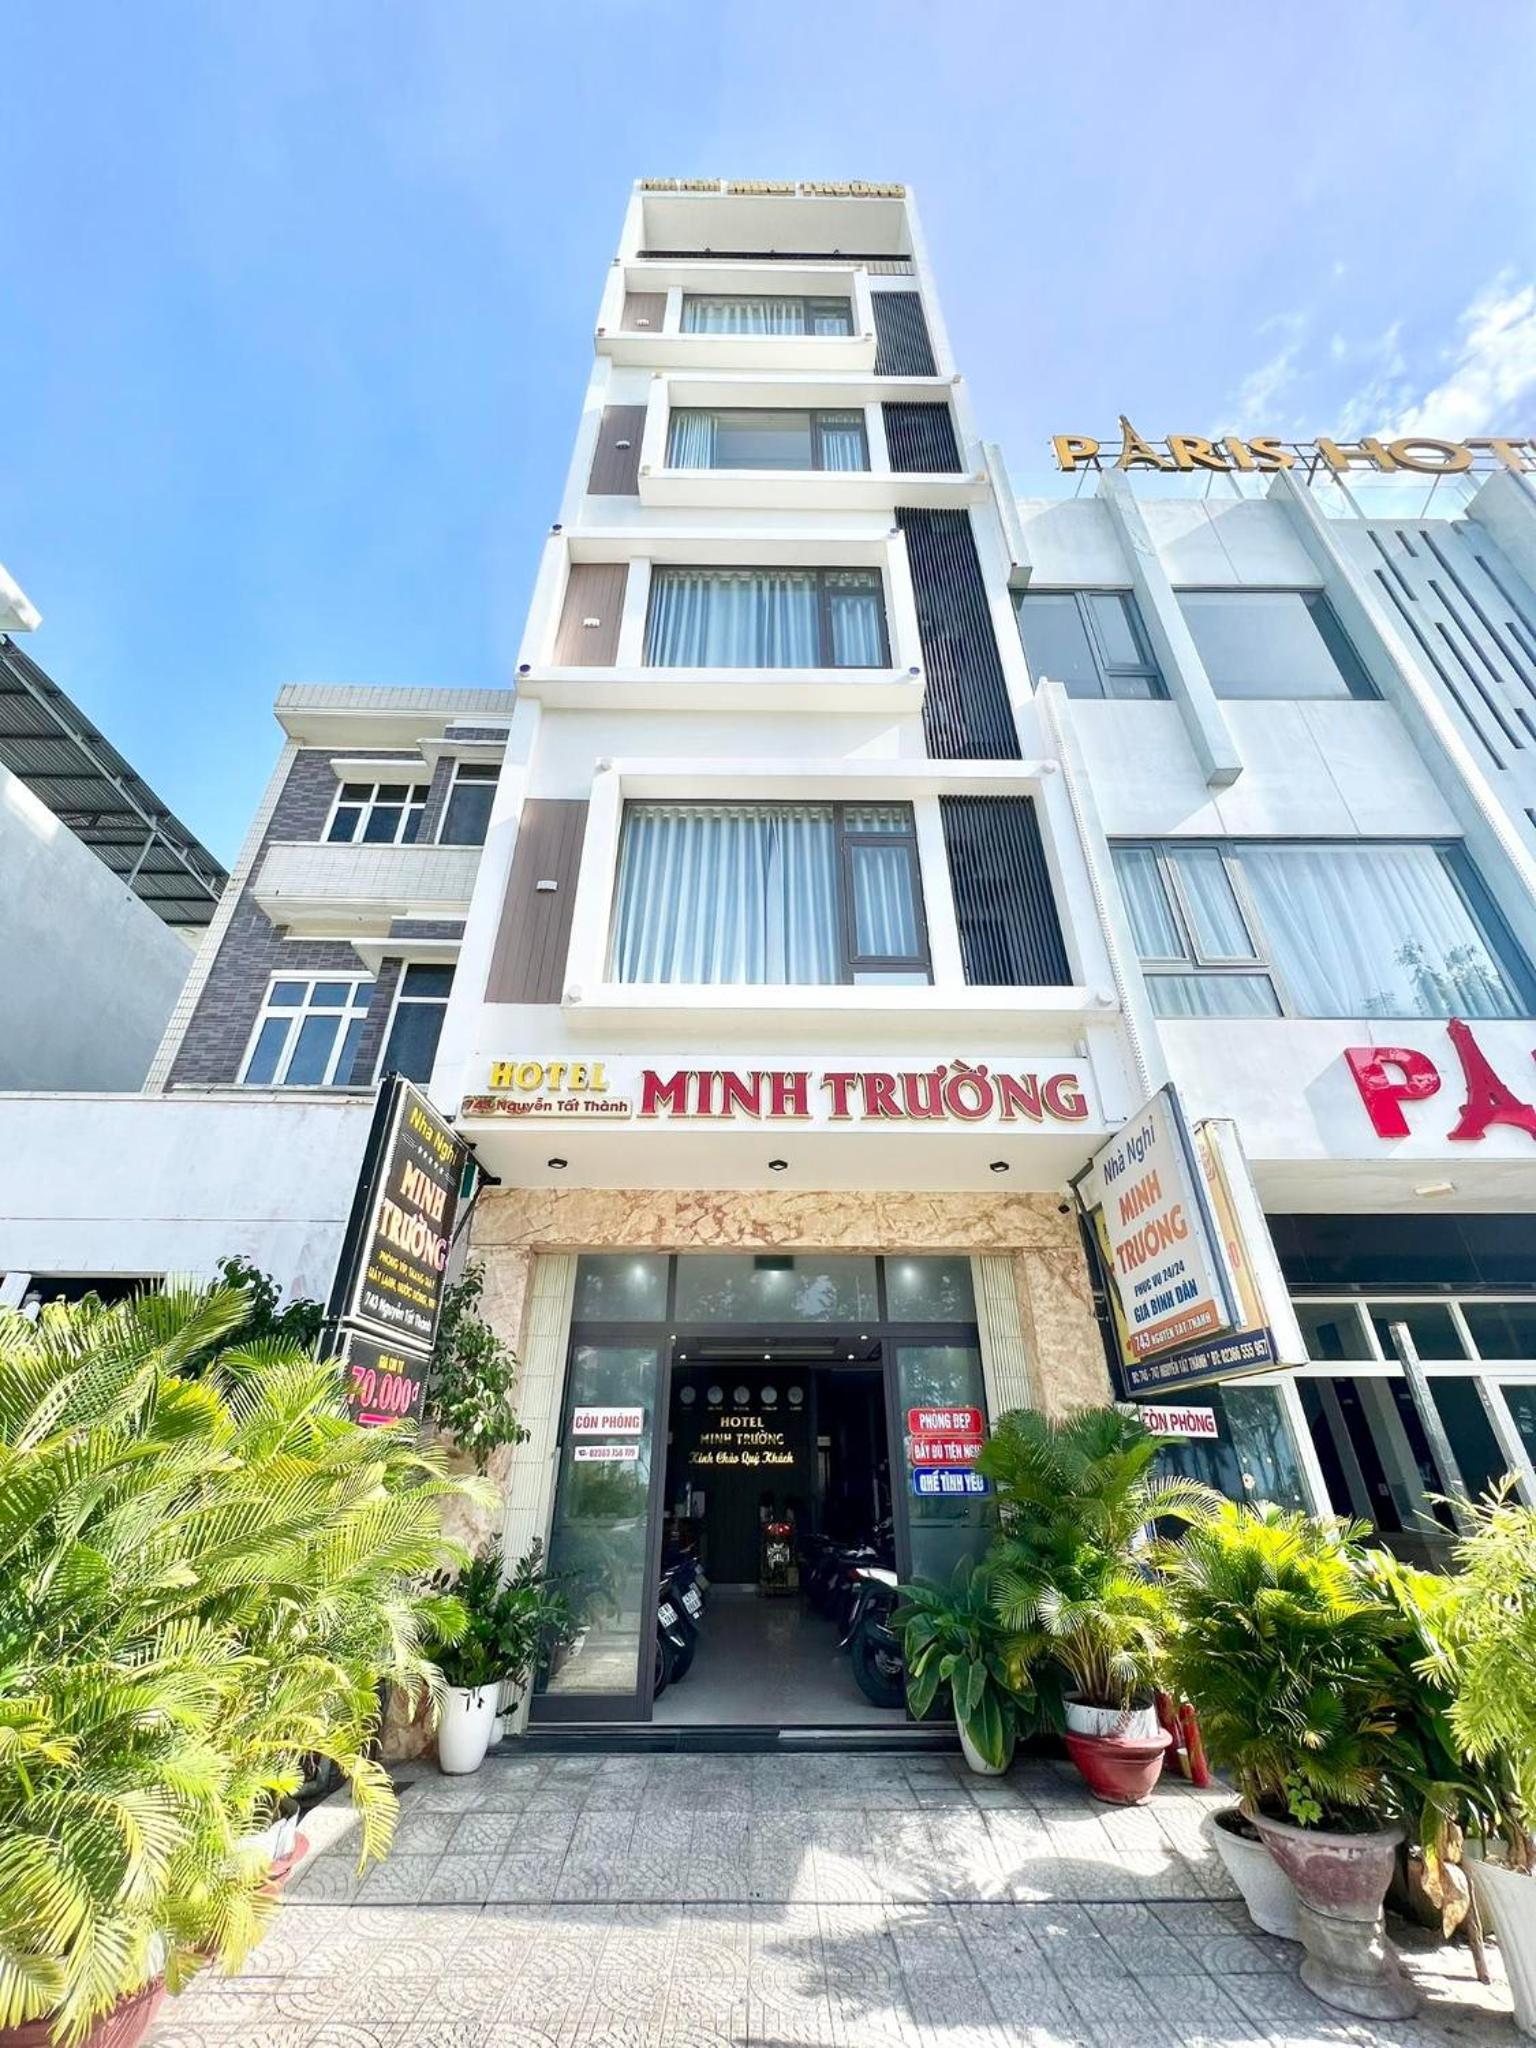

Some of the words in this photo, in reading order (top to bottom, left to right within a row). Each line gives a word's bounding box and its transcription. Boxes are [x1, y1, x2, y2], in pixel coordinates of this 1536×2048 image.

[1050, 415, 1294, 472] PARIS
[1315, 437, 1536, 474] HOT
[488, 1061, 609, 1092] HOTEL
[1343, 1017, 1536, 1141] PA
[637, 1069, 814, 1120] MINH
[820, 1058, 1091, 1122] TRƯỜNG
[496, 1097, 552, 1115] Nguyễn
[558, 1098, 579, 1112] Tất
[584, 1099, 628, 1113] Thành
[400, 1160, 448, 1222] MINH
[1119, 1169, 1162, 1227] MINH
[380, 1198, 448, 1272] TRƯỜNG
[1162, 1260, 1185, 1282] 24/24
[1135, 1332, 1151, 1352] 743
[601, 1412, 640, 1429] PHÒNG
[720, 1416, 765, 1428] HOTEL
[919, 1409, 952, 1429] PHÒNG
[1169, 1410, 1215, 1432] PHÒNG
[700, 1433, 732, 1445] MINH
[736, 1429, 785, 1445] TRƯỜNG
